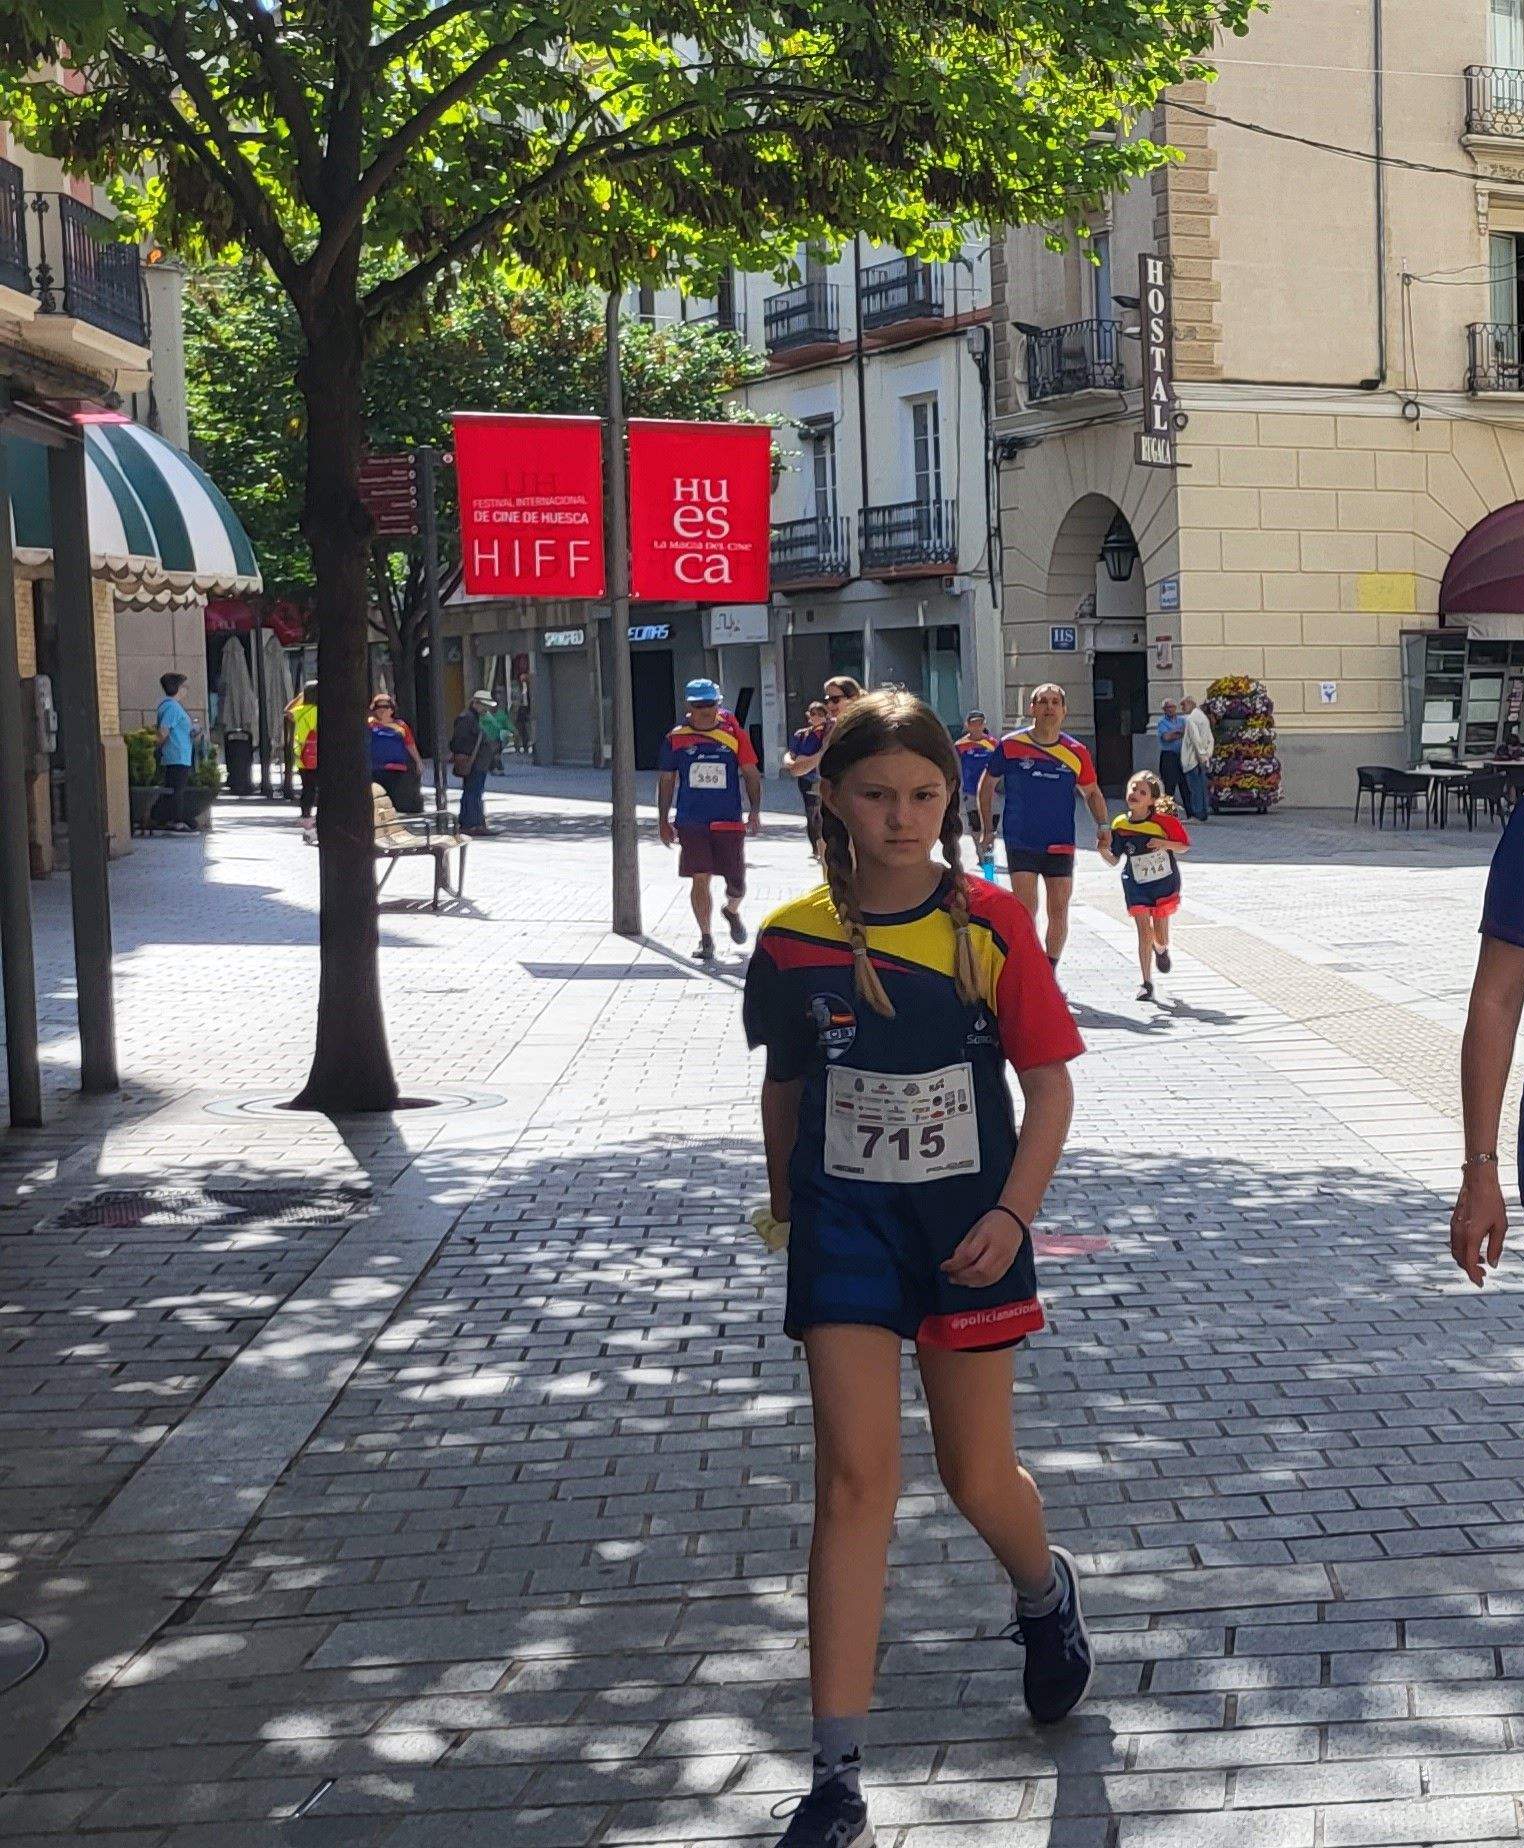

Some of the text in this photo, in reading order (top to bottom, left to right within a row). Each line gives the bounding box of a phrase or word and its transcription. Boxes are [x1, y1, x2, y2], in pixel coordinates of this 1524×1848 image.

[1146, 258, 1168, 431] HOSTAL
[473, 496, 587, 508] FESTIVAL INTERNACIONAL
[473, 511, 589, 524] DE CINE DE HUESCA
[673, 505, 730, 539] es
[474, 539, 590, 578] HIFF
[674, 553, 732, 584] ca
[857, 1123, 946, 1161] 715
